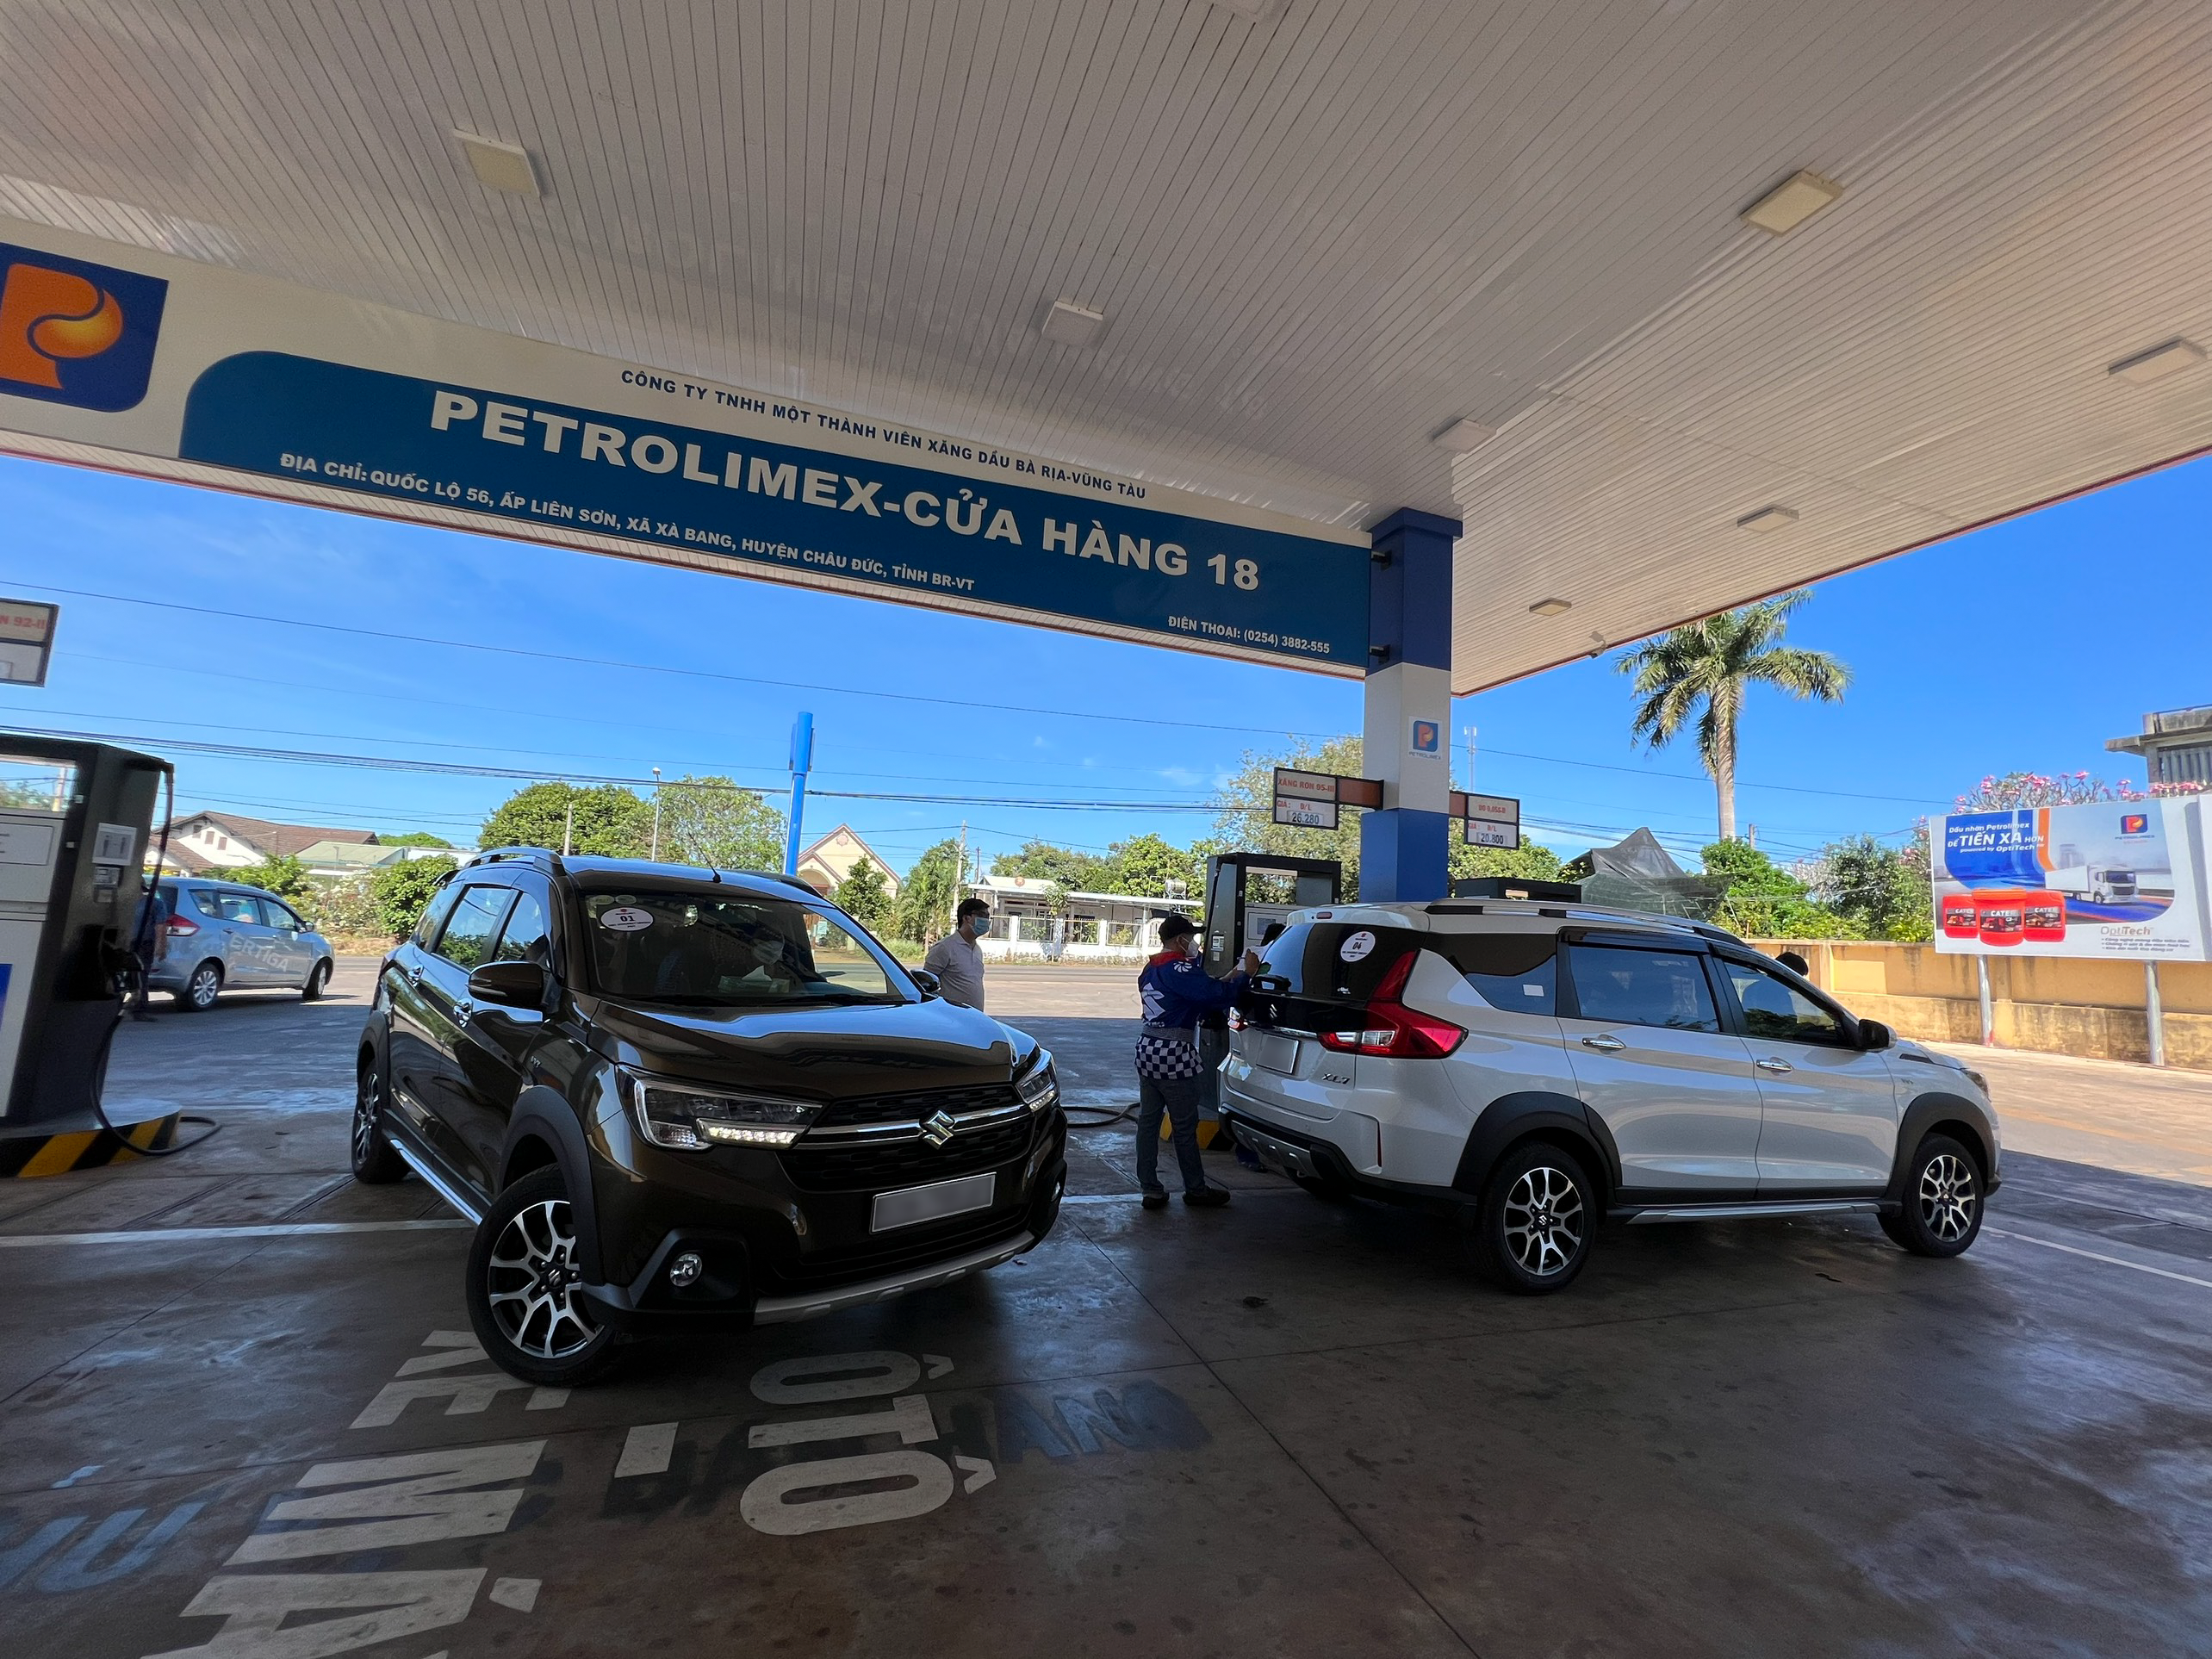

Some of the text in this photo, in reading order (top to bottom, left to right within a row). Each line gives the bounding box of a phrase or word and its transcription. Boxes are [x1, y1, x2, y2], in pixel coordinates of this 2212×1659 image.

[621, 370, 676, 394] CÔNG
[683, 383, 708, 401] TY
[714, 390, 766, 414] TNHH
[772, 404, 811, 424] MỘT
[817, 413, 877, 439] THÀNH
[882, 428, 923, 449] VIÊN
[927, 438, 972, 460] XĂNG
[1016, 458, 1036, 475] BÀ
[1041, 464, 1112, 492] RỊA-VŨNG
[1117, 482, 1146, 499] TÀU
[431, 389, 1258, 591] PETROLIMEX-CỬA HÀNG 18
[280, 452, 975, 591] ĐỊA CHỈ: QUỐC LỘ 56, ẤP LIÊN SƠN, XÃ XÀ BANG, HUYỆN CHÂU ĐỨC, TỈNH BR-VT
[1167, 615, 1330, 654] ĐIỆN THOẠI: (0254) 3882-555
[1278, 778, 1298, 787] XĂNG
[1299, 781, 1314, 790] RON
[1291, 812, 1320, 824] 26.280
[1985, 823, 2030, 831] Petrolimex
[1481, 833, 1504, 844] 20.800
[1959, 831, 1995, 847] TIẾN
[1998, 832, 2022, 844] XA
[1996, 844, 2035, 853] OptiTech
[2100, 926, 2151, 936] OptiTech
[1351, 941, 1362, 950] 04
[229, 932, 289, 972] ERTIGA
[1321, 1072, 1351, 1085] XL7
